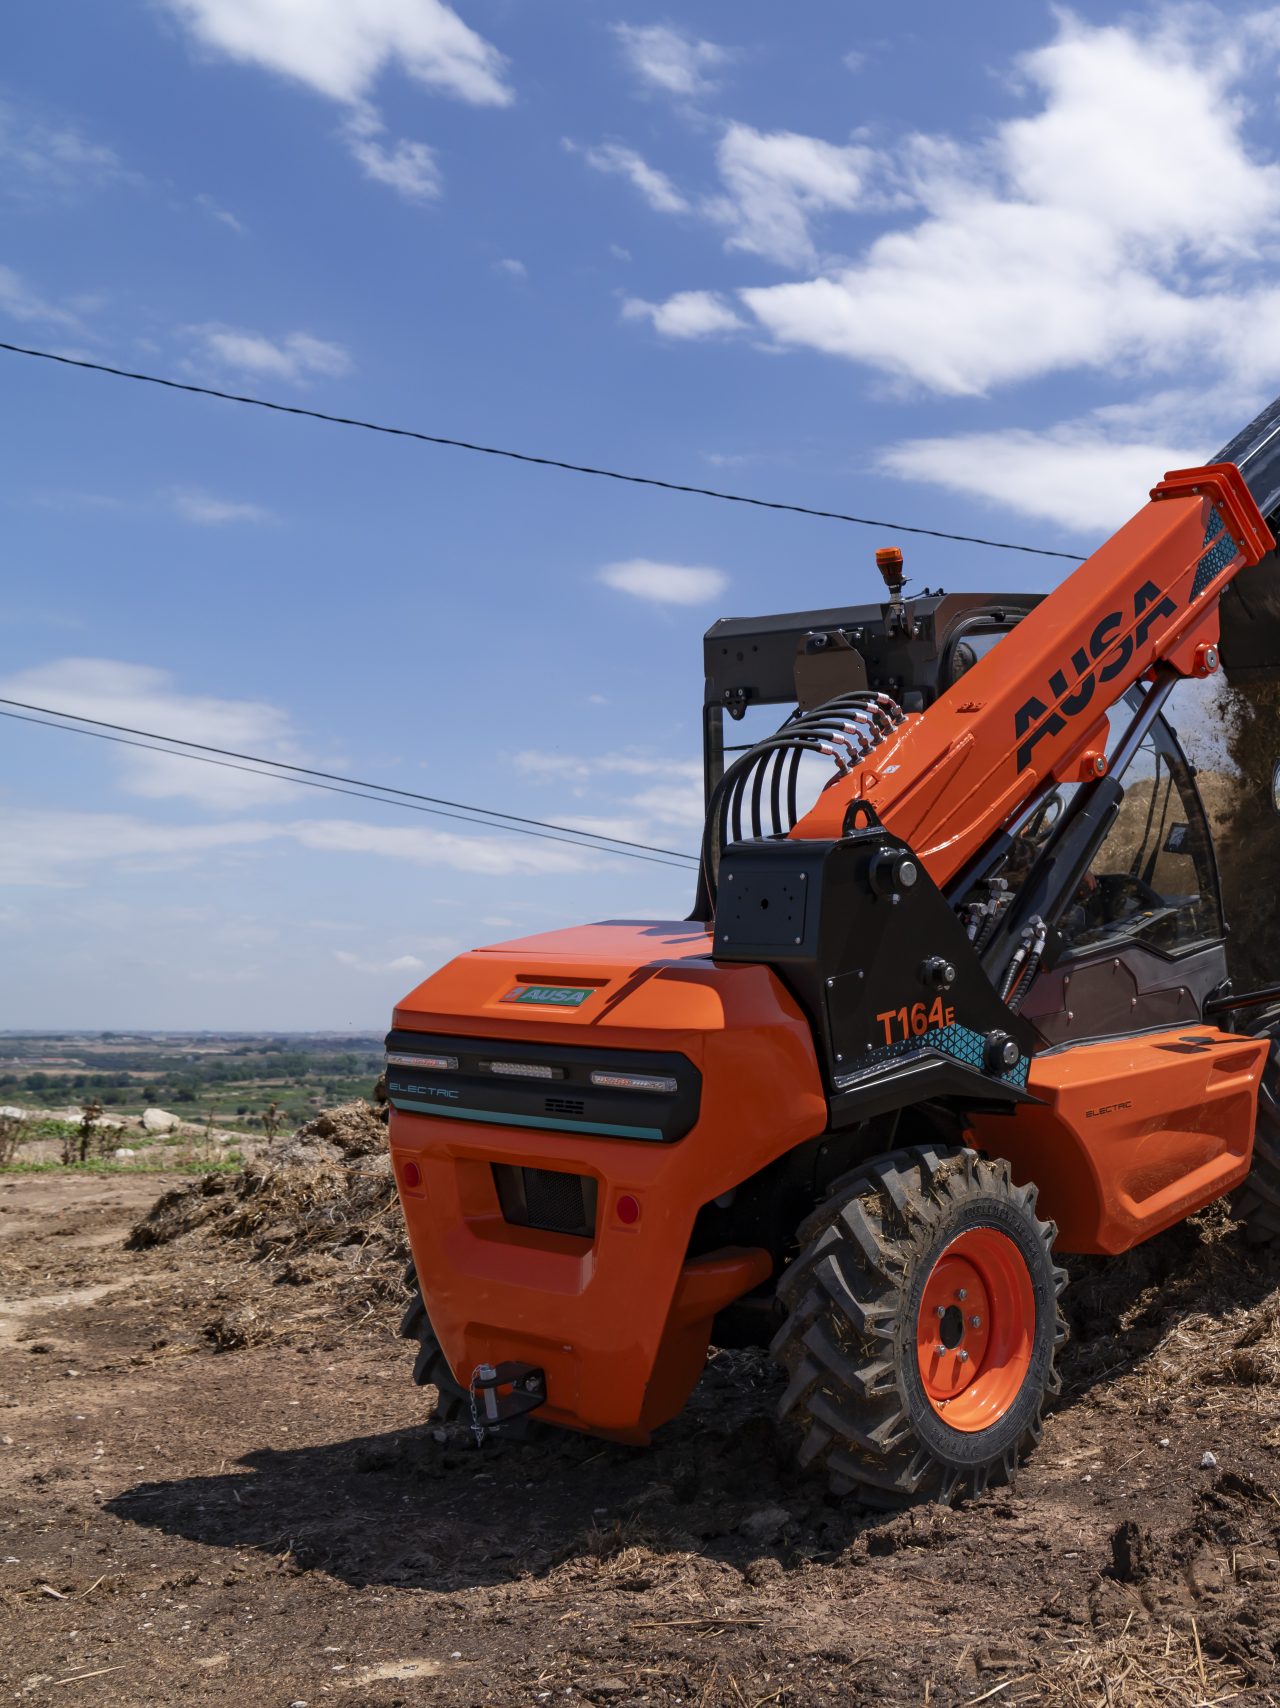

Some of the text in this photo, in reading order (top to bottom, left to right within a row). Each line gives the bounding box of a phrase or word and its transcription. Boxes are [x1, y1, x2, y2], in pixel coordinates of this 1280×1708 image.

[1015, 580, 1177, 775] AUSA
[521, 988, 585, 1002] AUSA
[876, 996, 956, 1046] T164E
[389, 1082, 459, 1099] ELECTRIC
[1085, 1100, 1132, 1118] ELECTRIC
